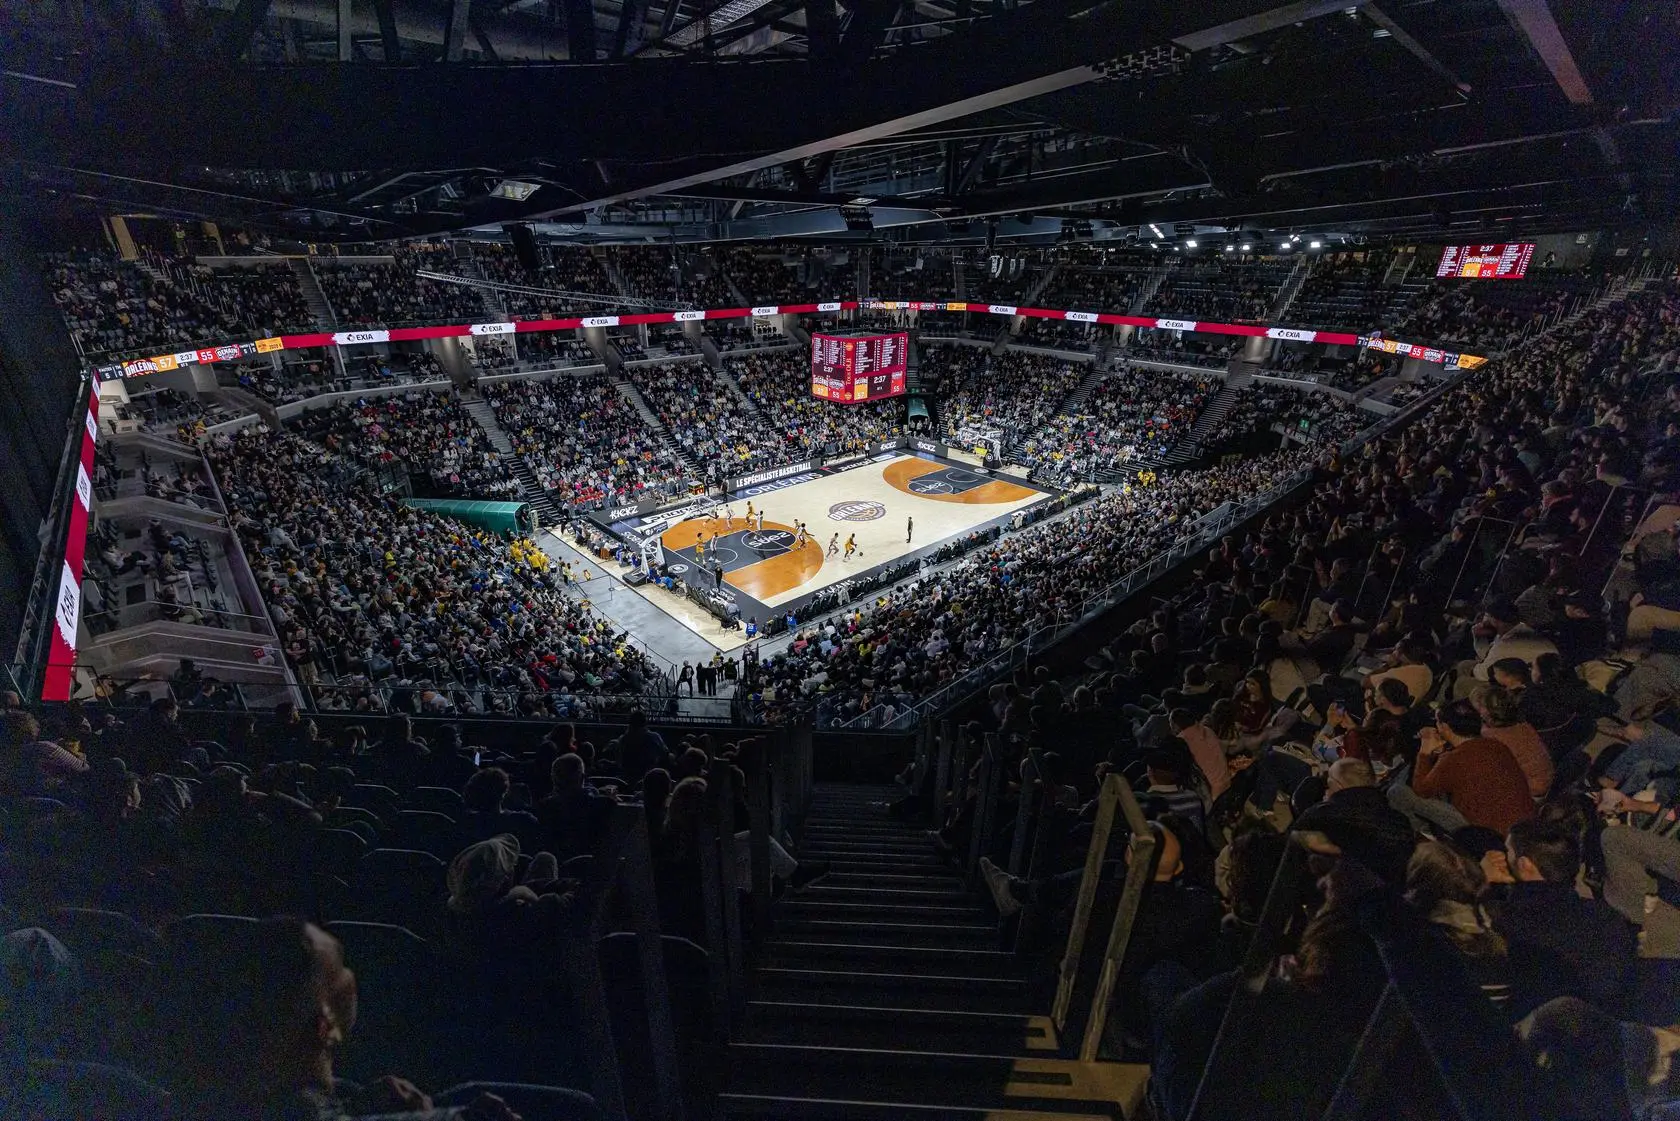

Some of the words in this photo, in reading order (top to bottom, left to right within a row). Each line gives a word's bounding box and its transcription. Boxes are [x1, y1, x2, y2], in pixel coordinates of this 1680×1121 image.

[1481, 269, 1493, 277] 55
[596, 318, 609, 326] EXIA
[1171, 321, 1184, 329] EXIA
[488, 325, 504, 333] EXIA
[356, 333, 374, 342] EXIA
[1285, 330, 1301, 339] EXIA
[1386, 341, 1395, 350] 57
[1411, 347, 1422, 357] 55
[125, 361, 159, 376] ORLEANS
[159, 357, 172, 368] 57
[180, 353, 193, 361] 2:37
[200, 350, 213, 361] 55
[873, 375, 886, 383] 2:37
[736, 478, 744, 488] LE
[744, 470, 779, 485] SPÉCIALISTE
[779, 461, 812, 475] BASKETBALL
[609, 506, 639, 520] KICKZ
[828, 501, 884, 521] ORLEANS
[748, 532, 792, 548] suez
